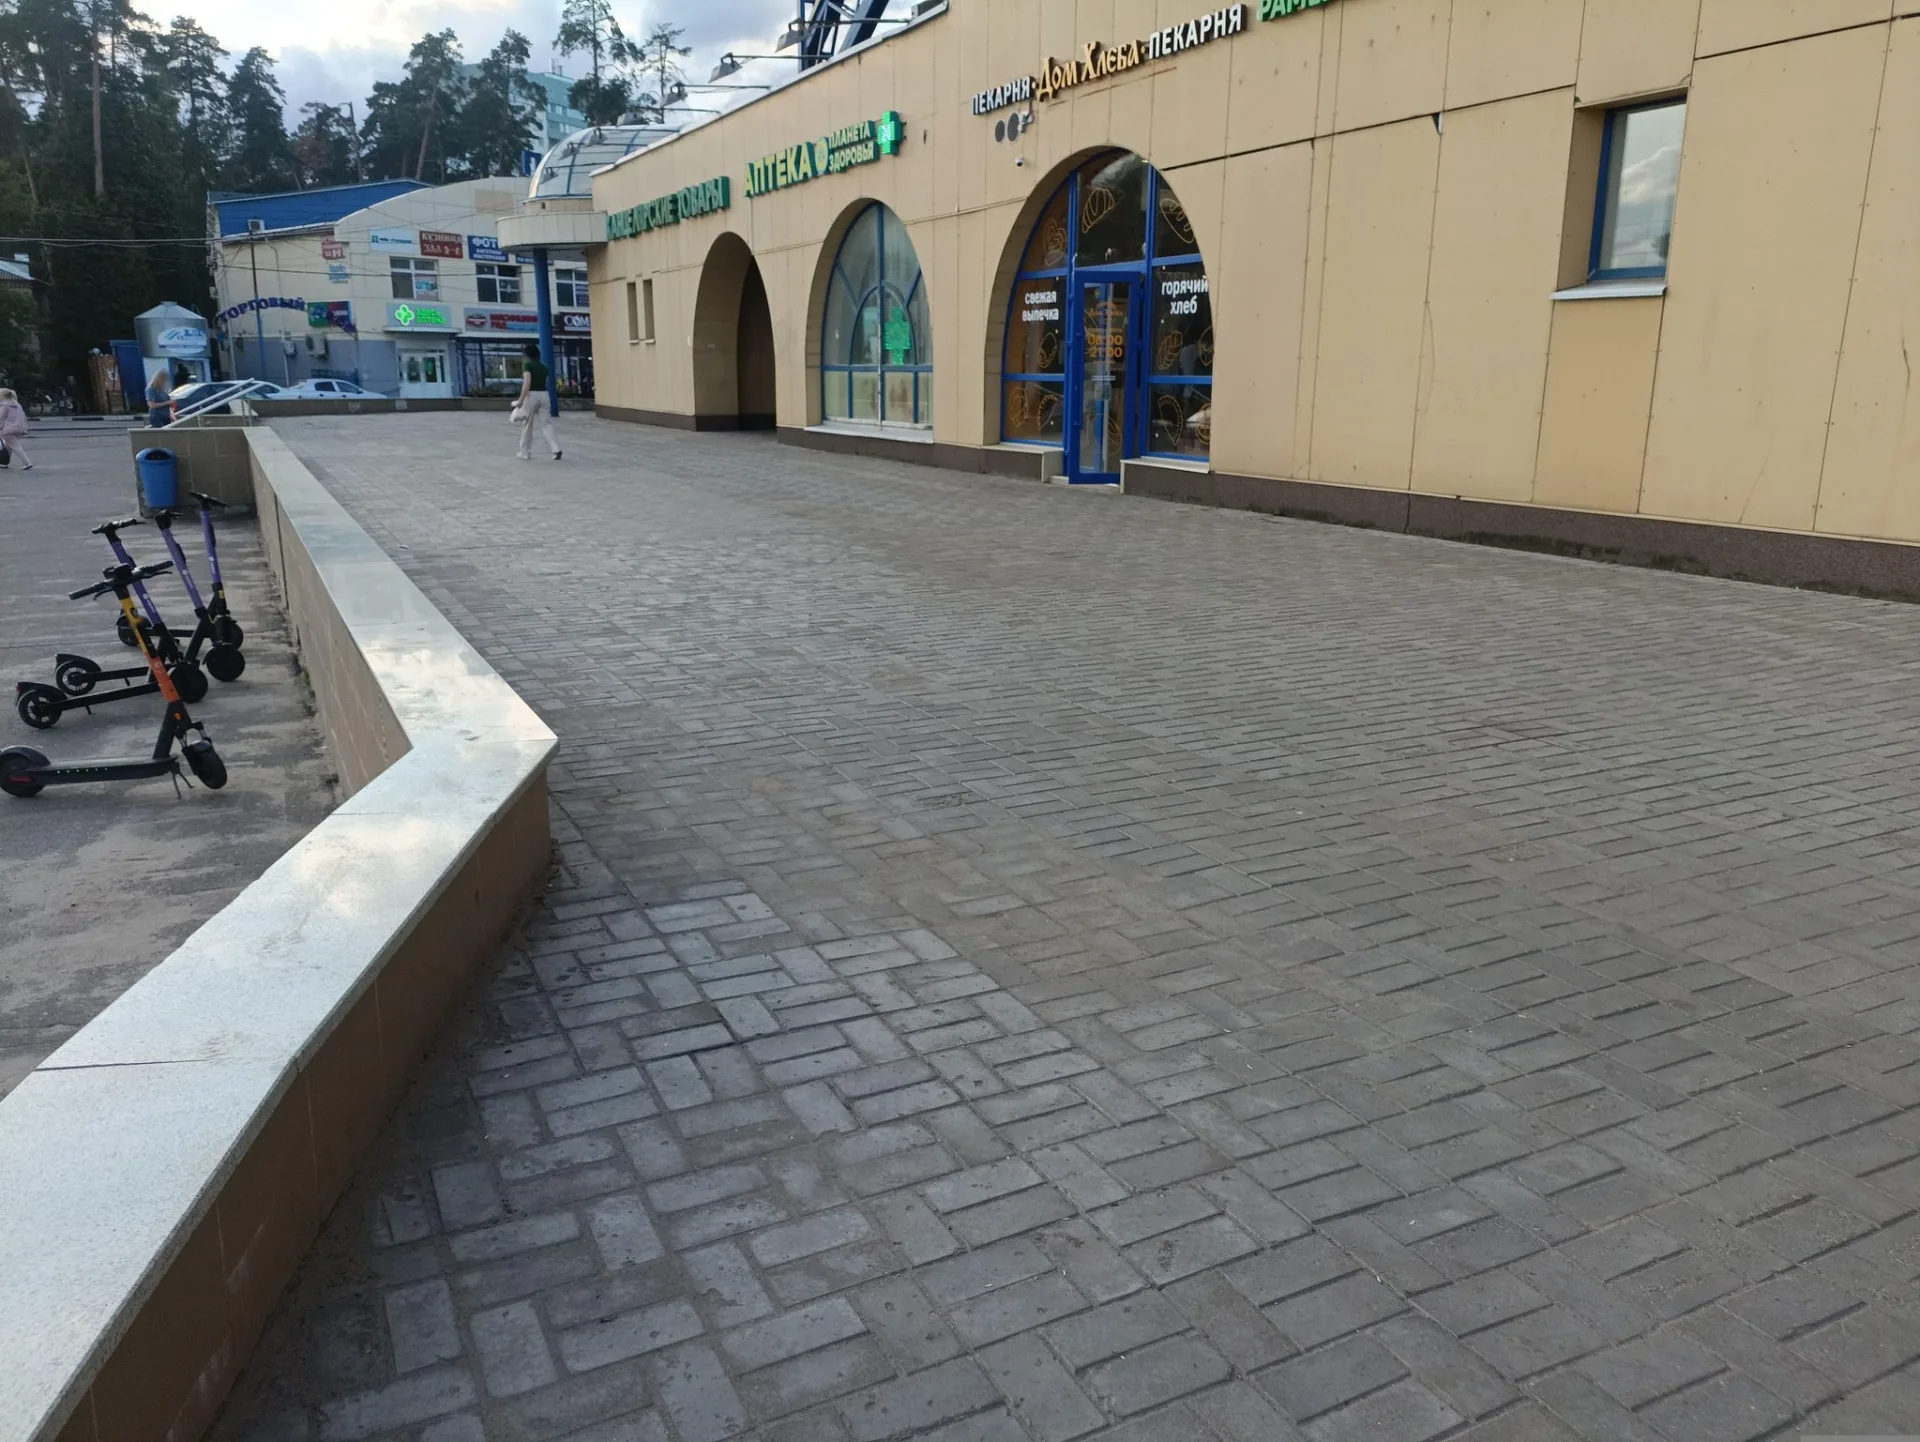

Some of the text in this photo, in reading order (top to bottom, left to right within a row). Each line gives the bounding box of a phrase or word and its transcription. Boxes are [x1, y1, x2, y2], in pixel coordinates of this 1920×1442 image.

[972, 76, 1030, 115] ПЕКАРНЯ
[1149, 4, 1242, 59] ПЕКАРНЯ
[828, 120, 871, 149] ПЛАНЕТА
[744, 142, 813, 197] АПТЕКА
[829, 141, 875, 172] ЗДОРОВЬЯ
[677, 176, 725, 220] ТОВАРЫ
[472, 237, 498, 249] ФОТ
[1025, 291, 1057, 305] свежая
[1161, 275, 1208, 298] горячий
[1022, 308, 1059, 322] выпечка
[1170, 295, 1198, 314] хлеб
